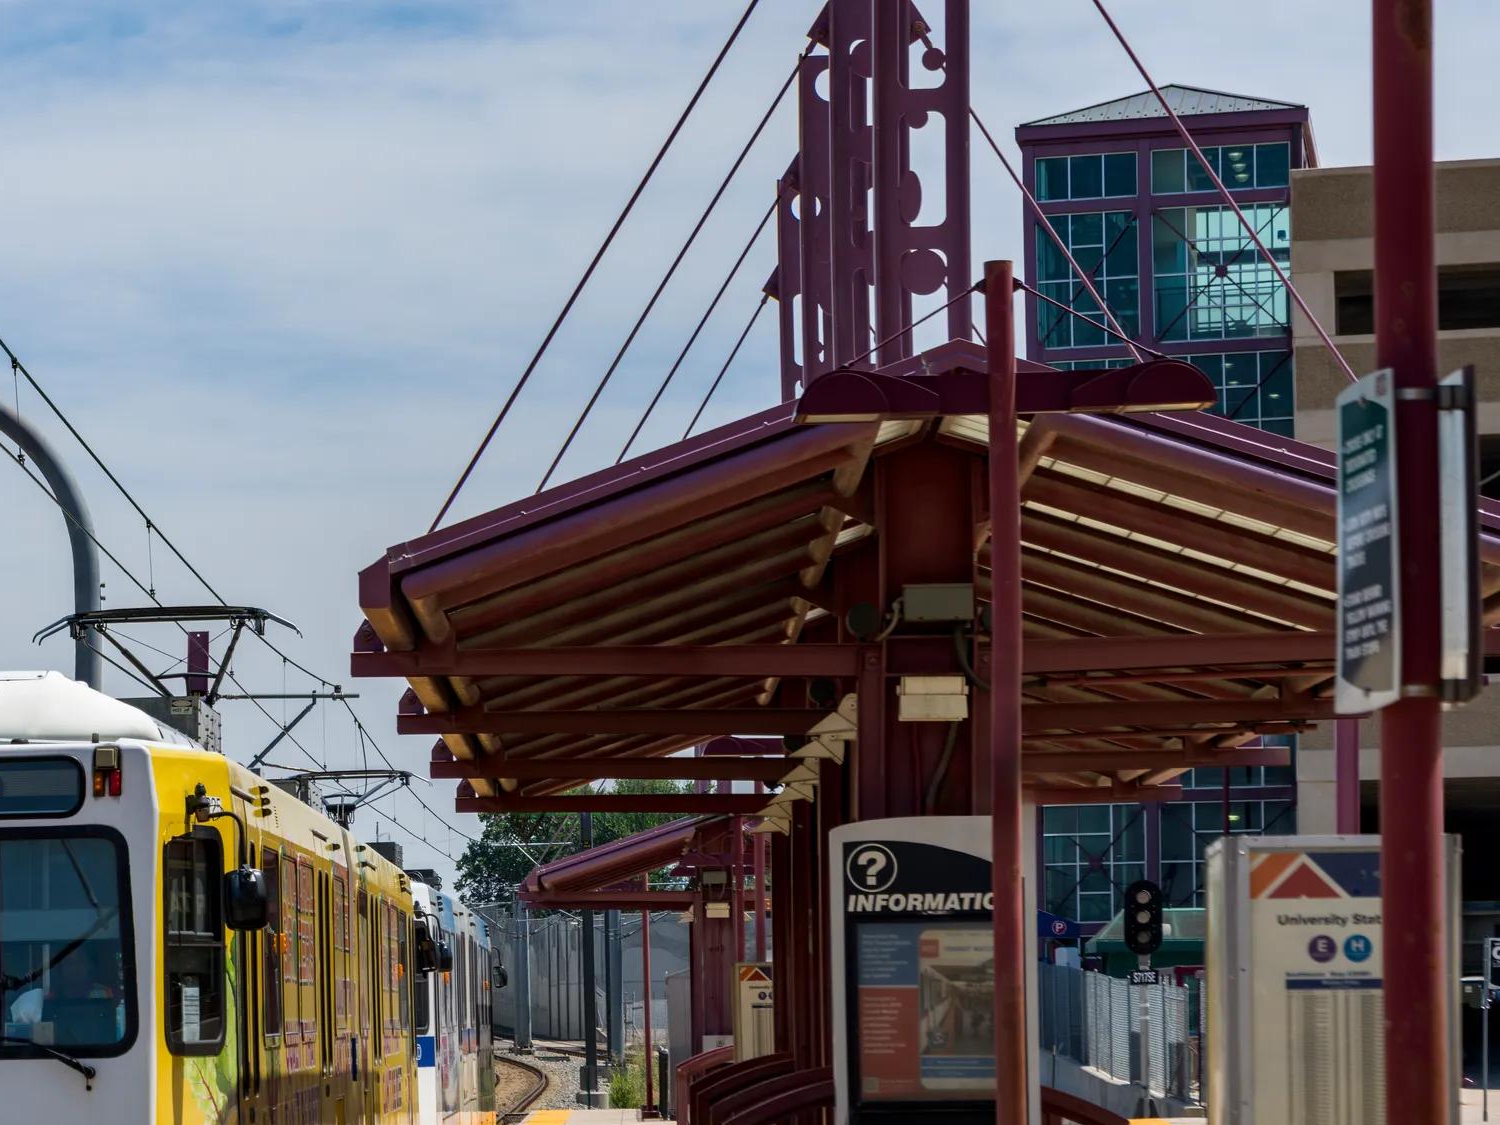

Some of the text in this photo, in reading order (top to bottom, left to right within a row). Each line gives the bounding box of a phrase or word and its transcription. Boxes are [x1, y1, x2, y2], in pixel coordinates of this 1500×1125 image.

[1277, 914, 1348, 927] University
[1317, 939, 1365, 952] E H
